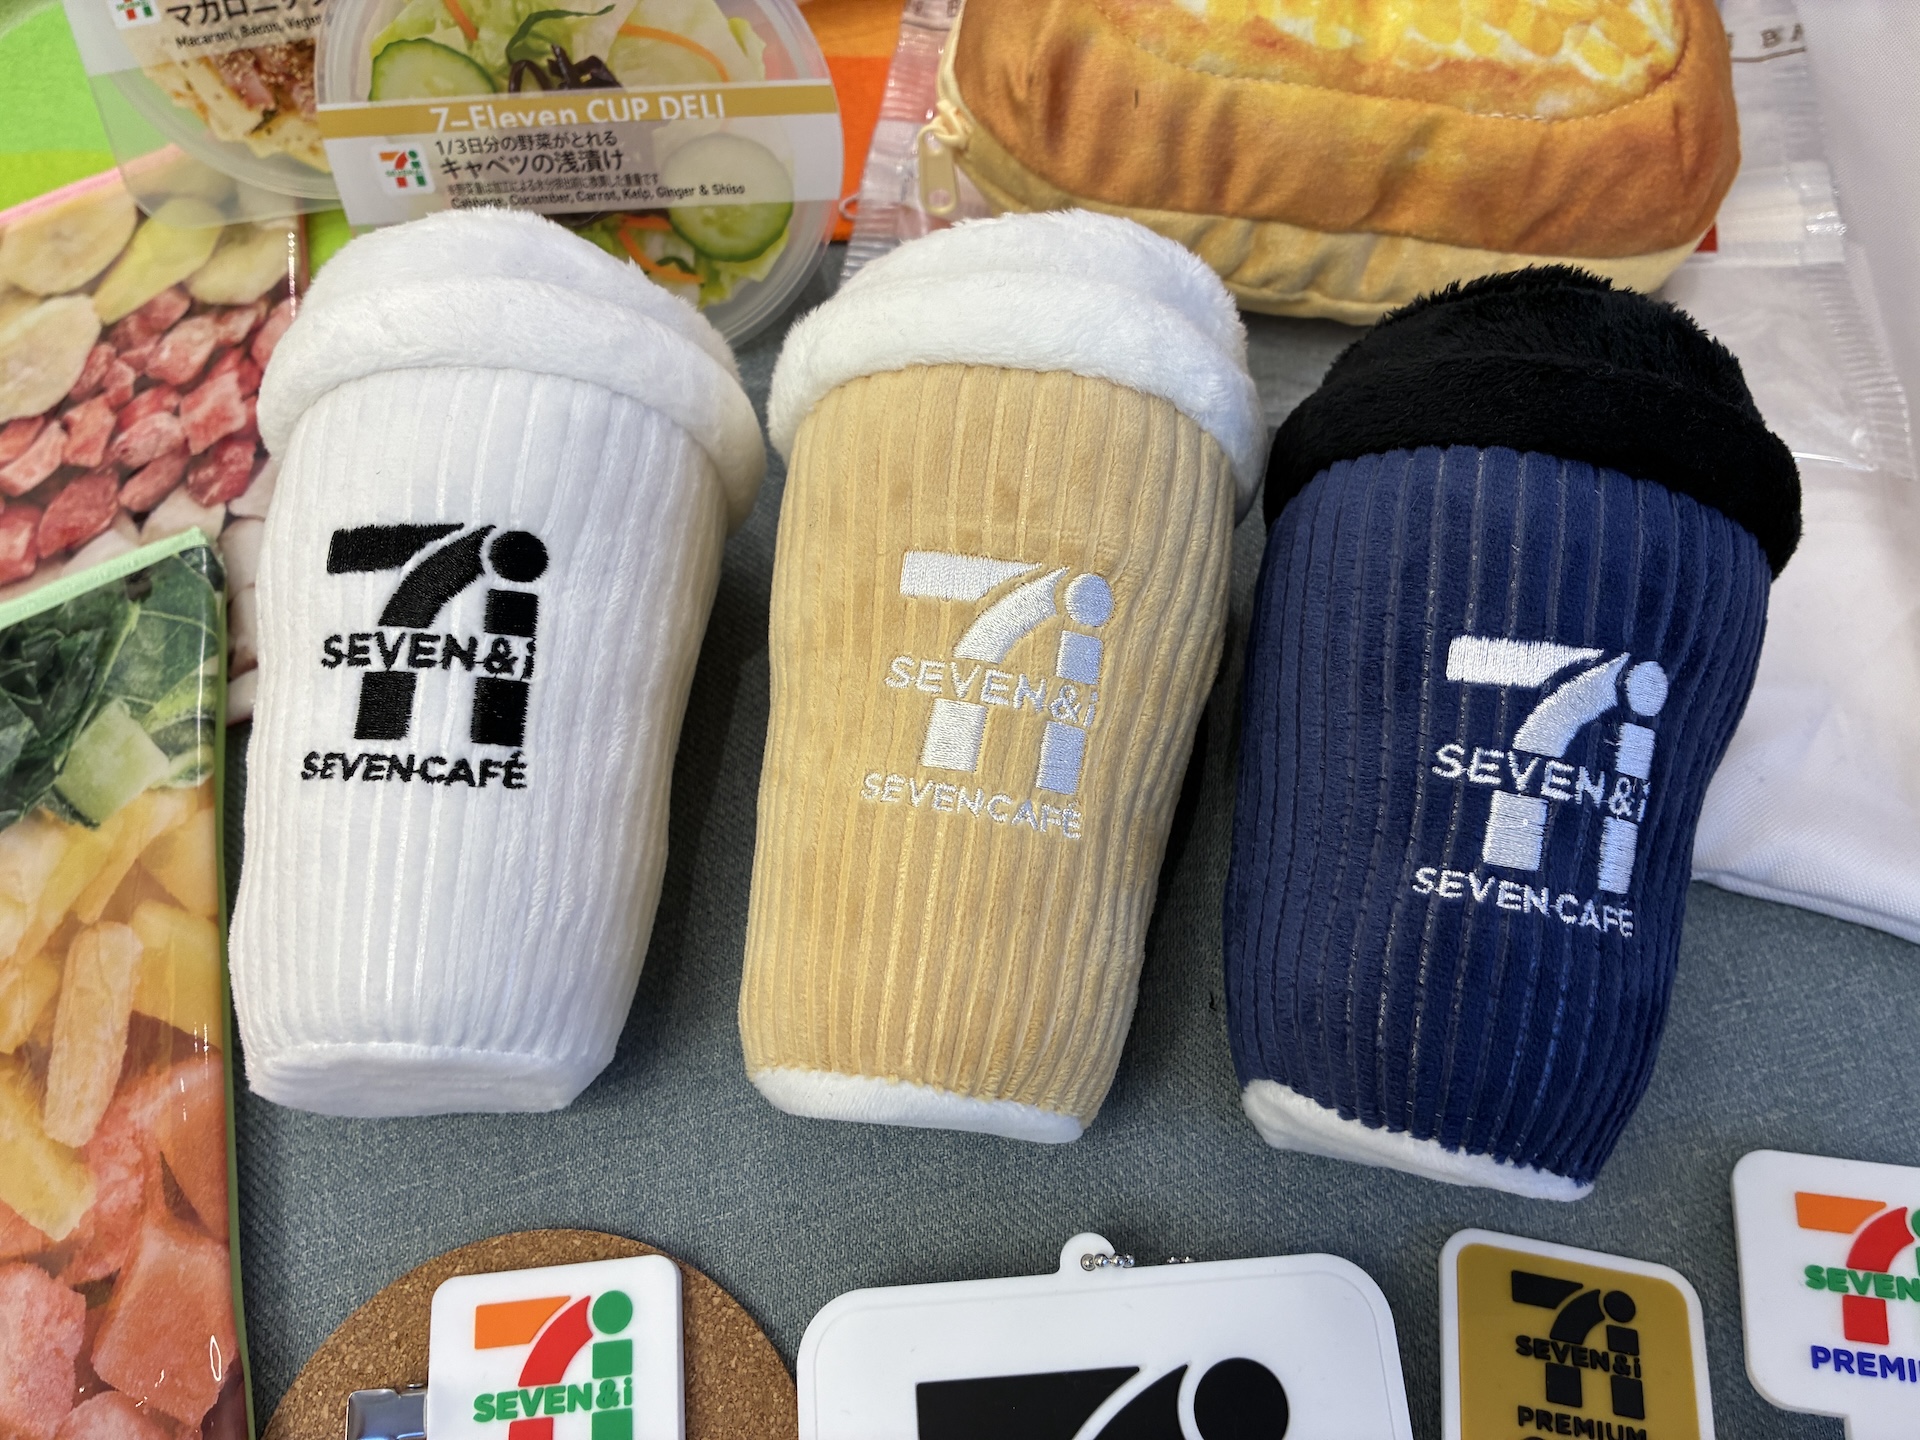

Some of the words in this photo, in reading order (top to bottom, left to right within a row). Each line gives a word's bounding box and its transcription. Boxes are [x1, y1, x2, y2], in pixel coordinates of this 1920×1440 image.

[587, 97, 649, 123] CUP
[658, 93, 725, 120] DELI
[435, 130, 618, 156] 1/3日分の野菜がとれる
[440, 148, 623, 179] キャベツの浅漬け
[656, 185, 694, 200] Ginger
[699, 184, 709, 196] &
[1810, 1344, 1920, 1383] PREMI
[472, 1376, 634, 1424] SEVEN&i
[1517, 1405, 1647, 1440] PREMIUM
